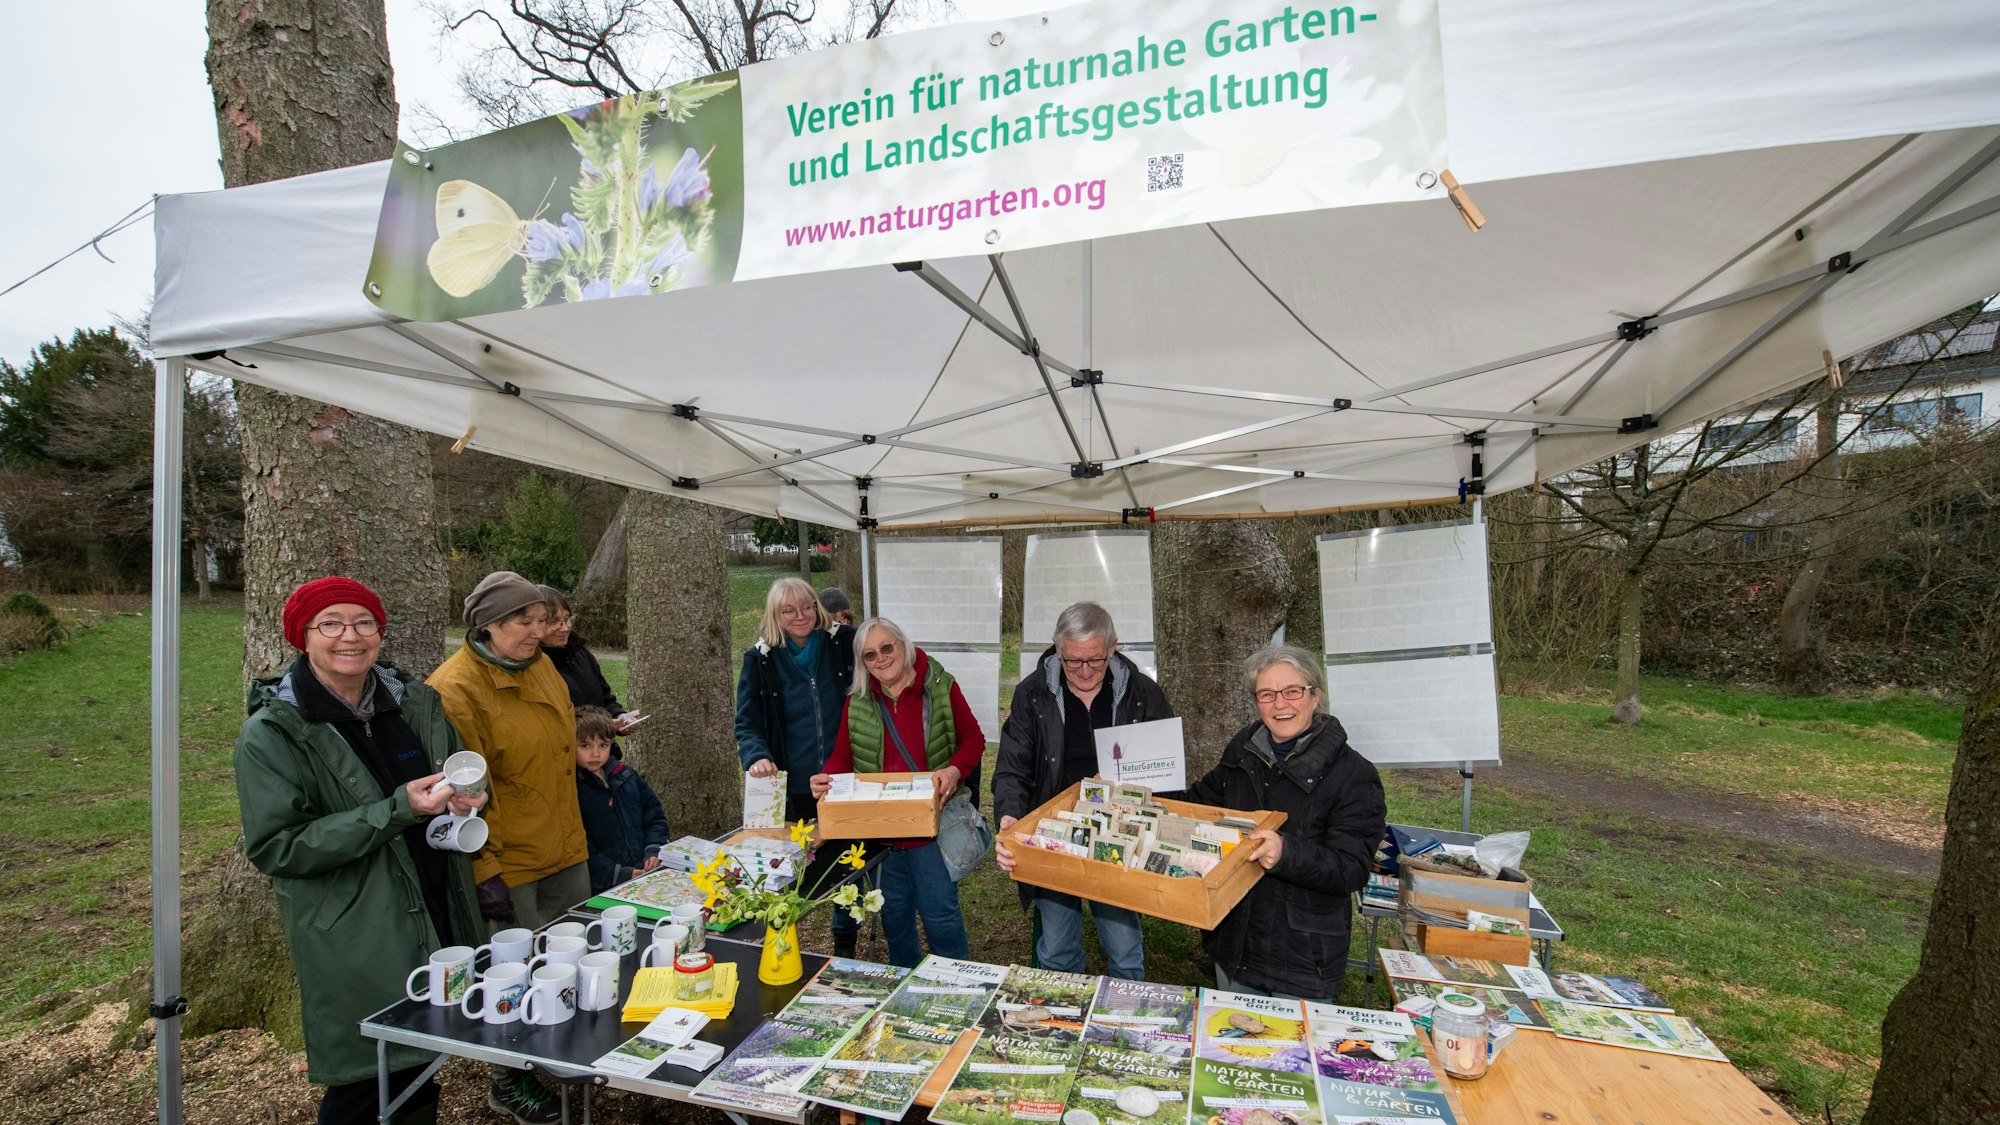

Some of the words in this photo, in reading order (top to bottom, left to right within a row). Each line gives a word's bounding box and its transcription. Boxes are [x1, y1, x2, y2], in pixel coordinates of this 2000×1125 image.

[787, 87, 894, 137] Verein
[909, 72, 964, 113] für
[979, 35, 1186, 101] naturnahe
[1205, 5, 1377, 58] Garten-
[789, 142, 848, 187] und
[865, 66, 1328, 172] Landschaftsgestaltung
[785, 178, 1106, 247] www.naturgarten.org
[1122, 761, 1166, 772] NaturGarten
[951, 962, 983, 970] Natur
[958, 968, 999, 978] Garten
[1016, 969, 1061, 980] NATUR
[1036, 978, 1088, 990] GARTEN
[1109, 981, 1155, 993] NATUR
[1130, 989, 1186, 1002] GARTEN
[1233, 995, 1271, 1005] Natur
[1246, 1002, 1295, 1013] Garten
[1336, 1008, 1376, 1018] Natur
[771, 1021, 804, 1032] Natur
[902, 1020, 938, 1031] Natur
[1350, 1015, 1403, 1027] Garten
[908, 1027, 956, 1041] Garten
[988, 1034, 1040, 1050] NATUR
[995, 1044, 1006, 1054] &
[1009, 1047, 1072, 1061] GARTEN
[1088, 1048, 1143, 1066] NATUR
[1098, 1058, 1110, 1069] &
[1113, 1062, 1180, 1079] GARTEN
[1204, 1064, 1263, 1082] NATUR
[1217, 1074, 1230, 1086] &
[1233, 1078, 1305, 1096] GARTEN
[1330, 1082, 1396, 1101] NATUR
[1346, 1093, 1360, 1105] &
[1364, 1097, 1441, 1116] GARTEN
